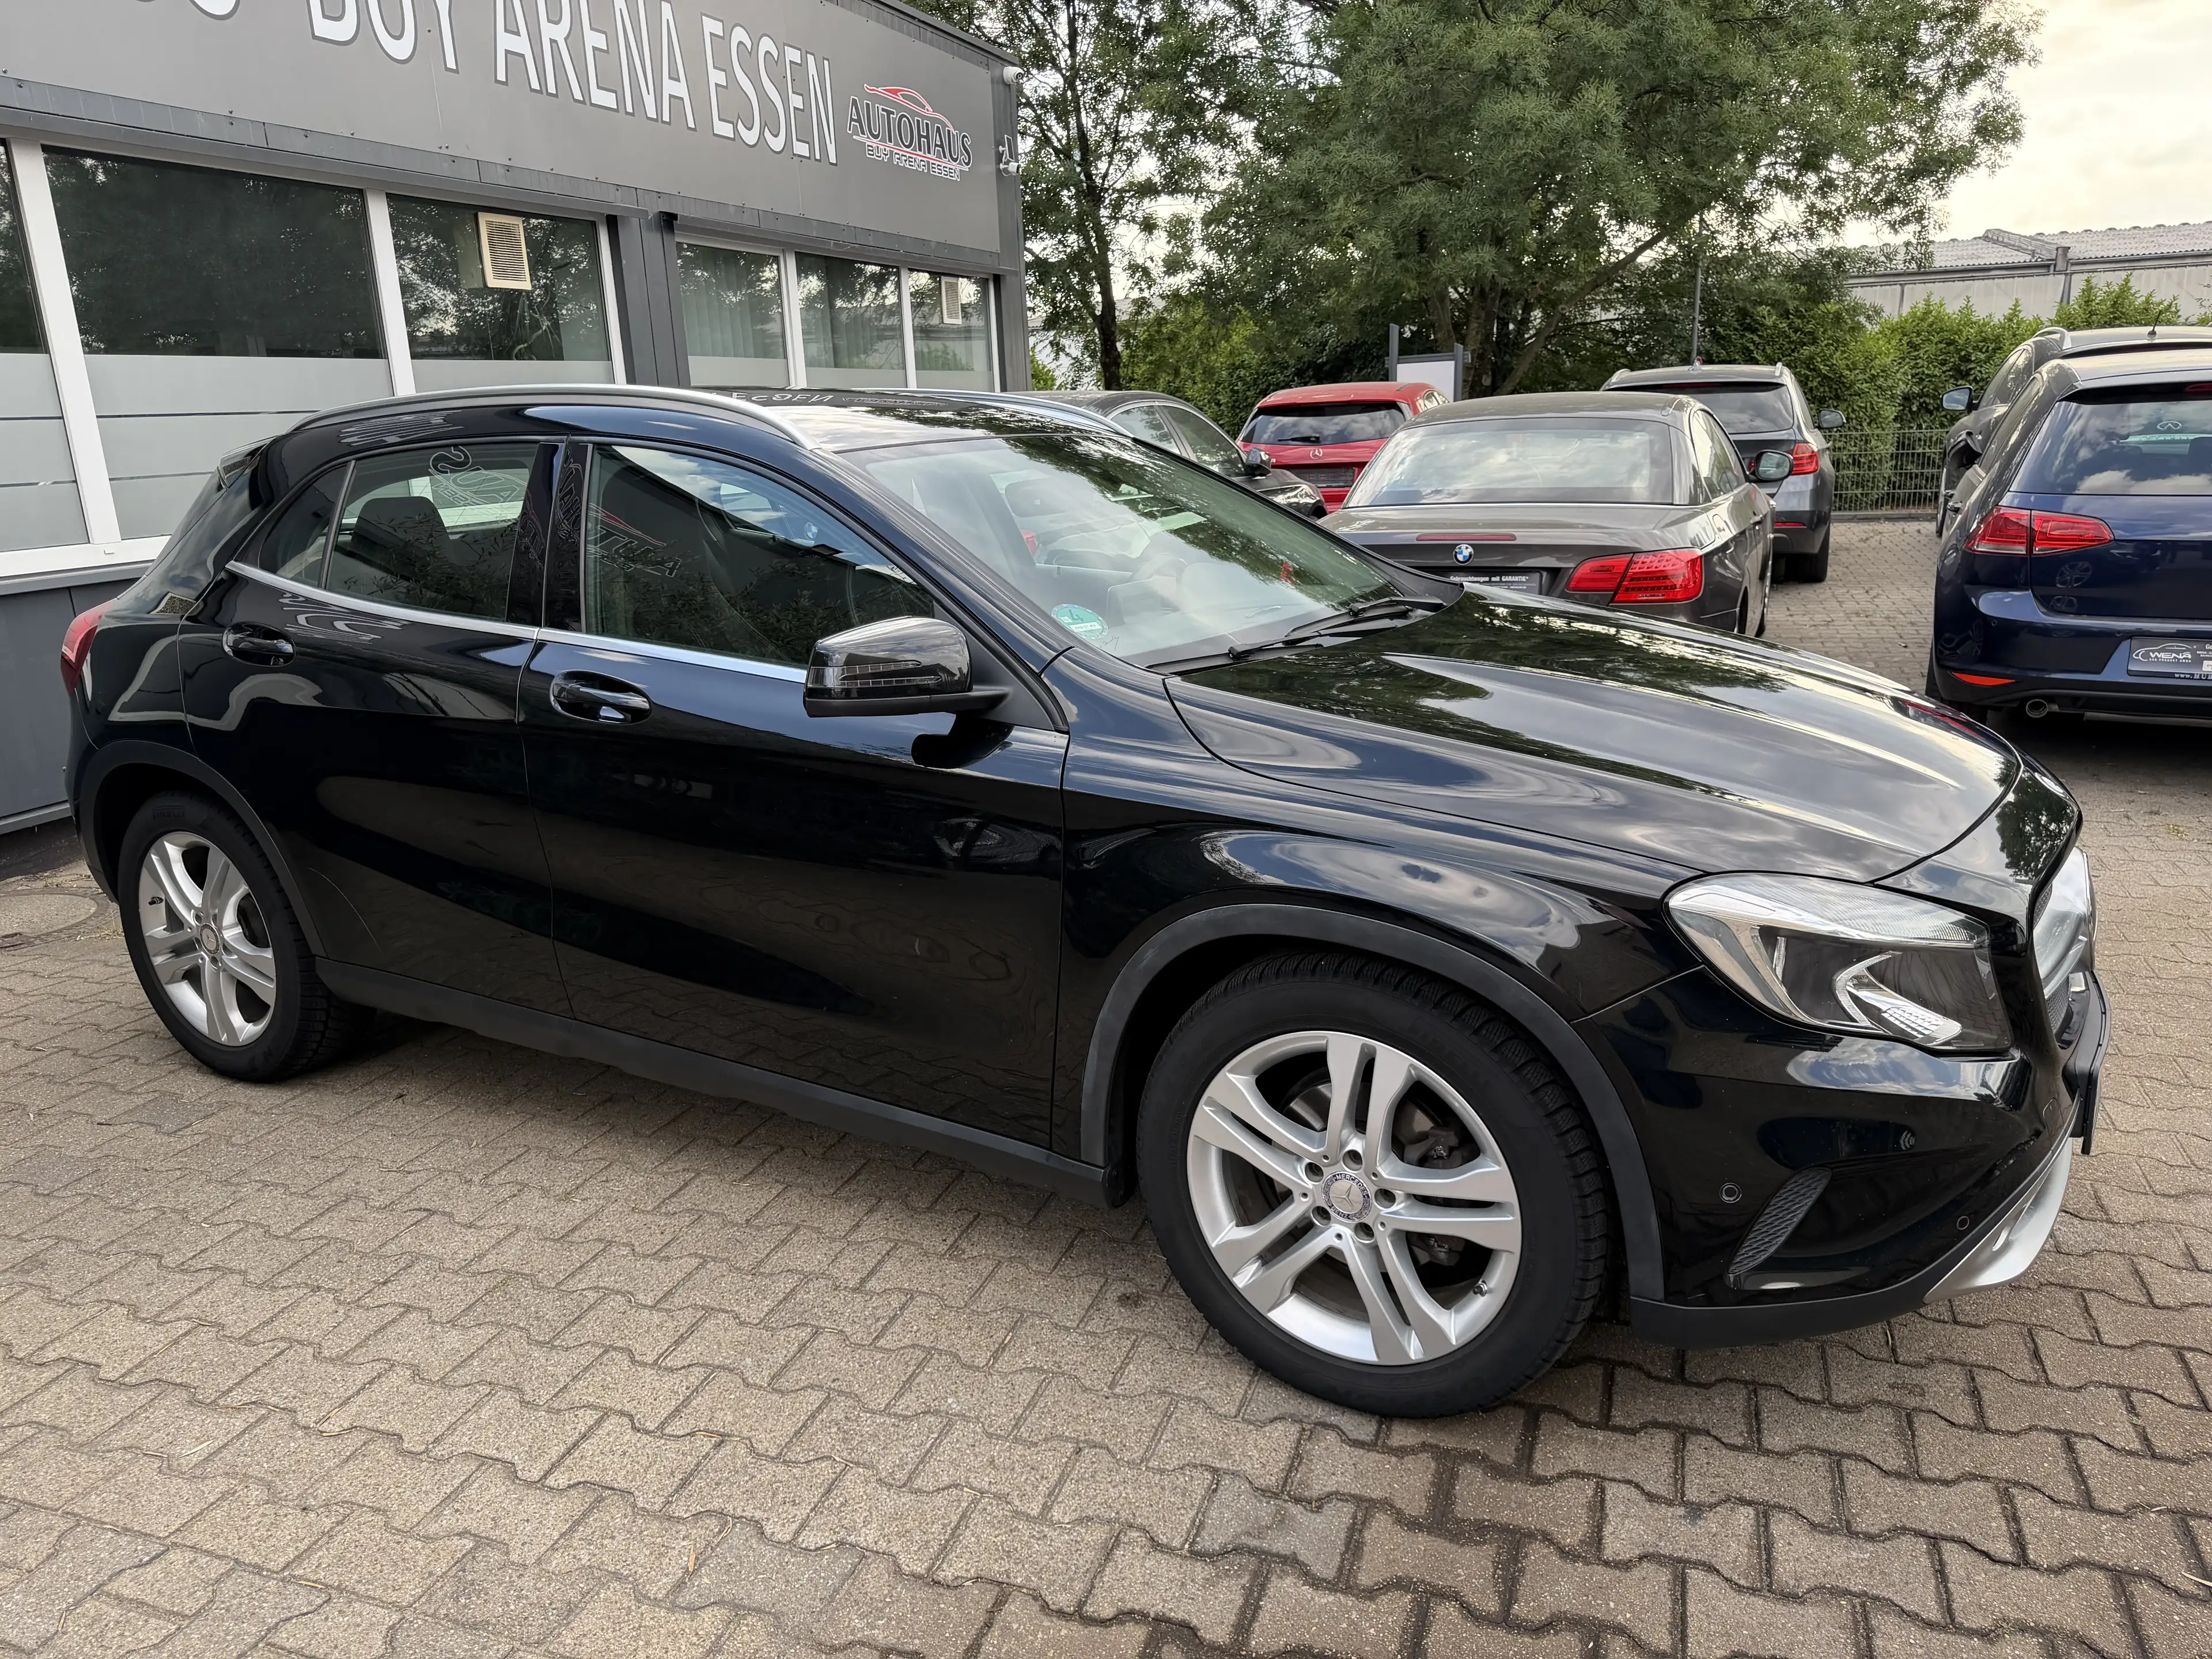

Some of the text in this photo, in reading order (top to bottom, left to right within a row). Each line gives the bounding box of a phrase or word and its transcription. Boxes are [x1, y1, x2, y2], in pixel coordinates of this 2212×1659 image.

[495, 0, 698, 132] ARENA
[700, 12, 838, 166] ESSEN
[847, 96, 972, 168] AUTOHAUS
[866, 143, 960, 181] BUY ARENA ESSEN
[1069, 609, 1084, 622] 4
[1336, 1174, 1368, 1196] MERCEDES
[1331, 1206, 1349, 1219] BENZ
